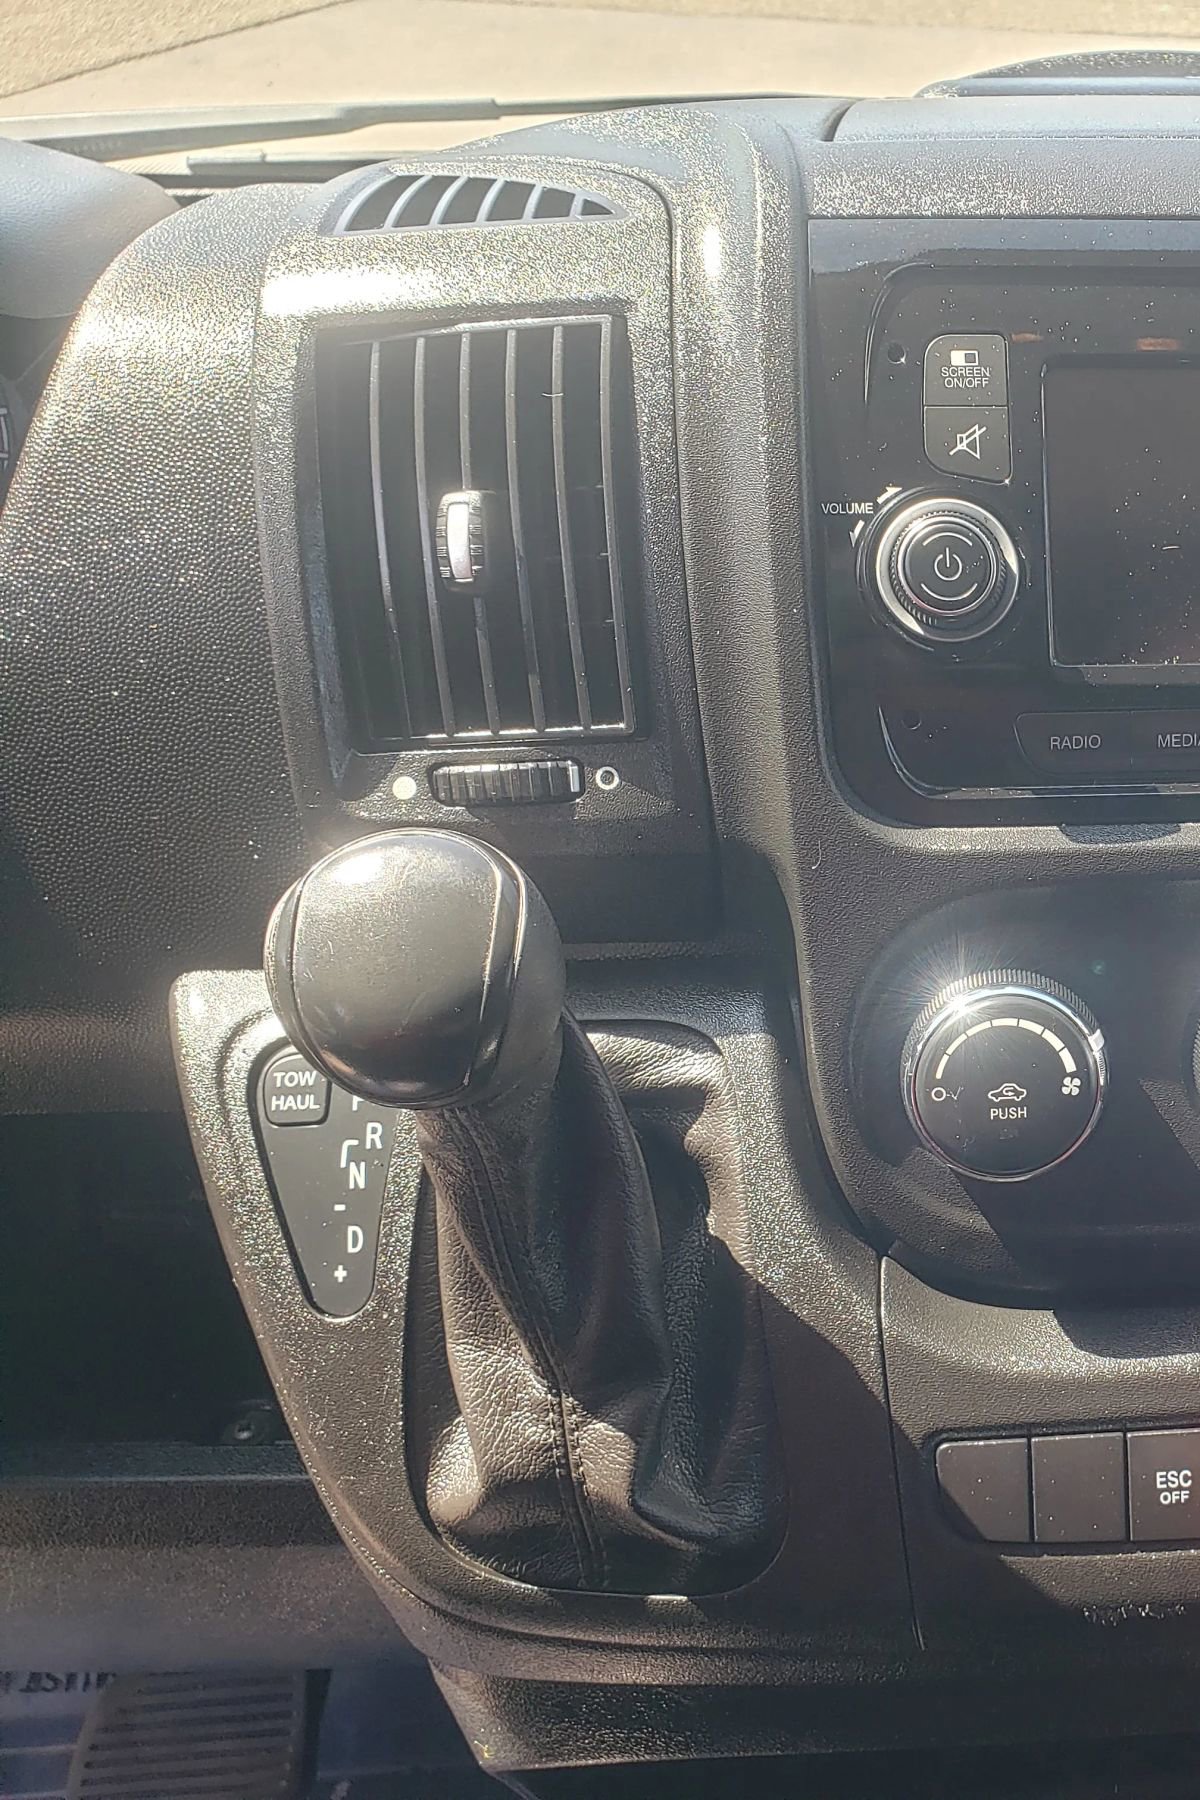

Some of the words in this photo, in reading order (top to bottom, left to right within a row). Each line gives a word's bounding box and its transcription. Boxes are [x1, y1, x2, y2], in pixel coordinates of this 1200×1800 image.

[941, 366, 990, 377] SCREEN
[944, 377, 989, 389] ON/OFF
[821, 502, 874, 515] VOLUME
[1049, 735, 1101, 750] RADIO
[273, 1070, 317, 1088] TOW
[271, 1094, 320, 1111] HAUL
[989, 1106, 1028, 1121] PUSH
[365, 1121, 383, 1150] R
[349, 1161, 366, 1189] N
[347, 1225, 364, 1253] D
[1155, 1470, 1193, 1489] ESC
[1159, 1491, 1190, 1505] OFF
